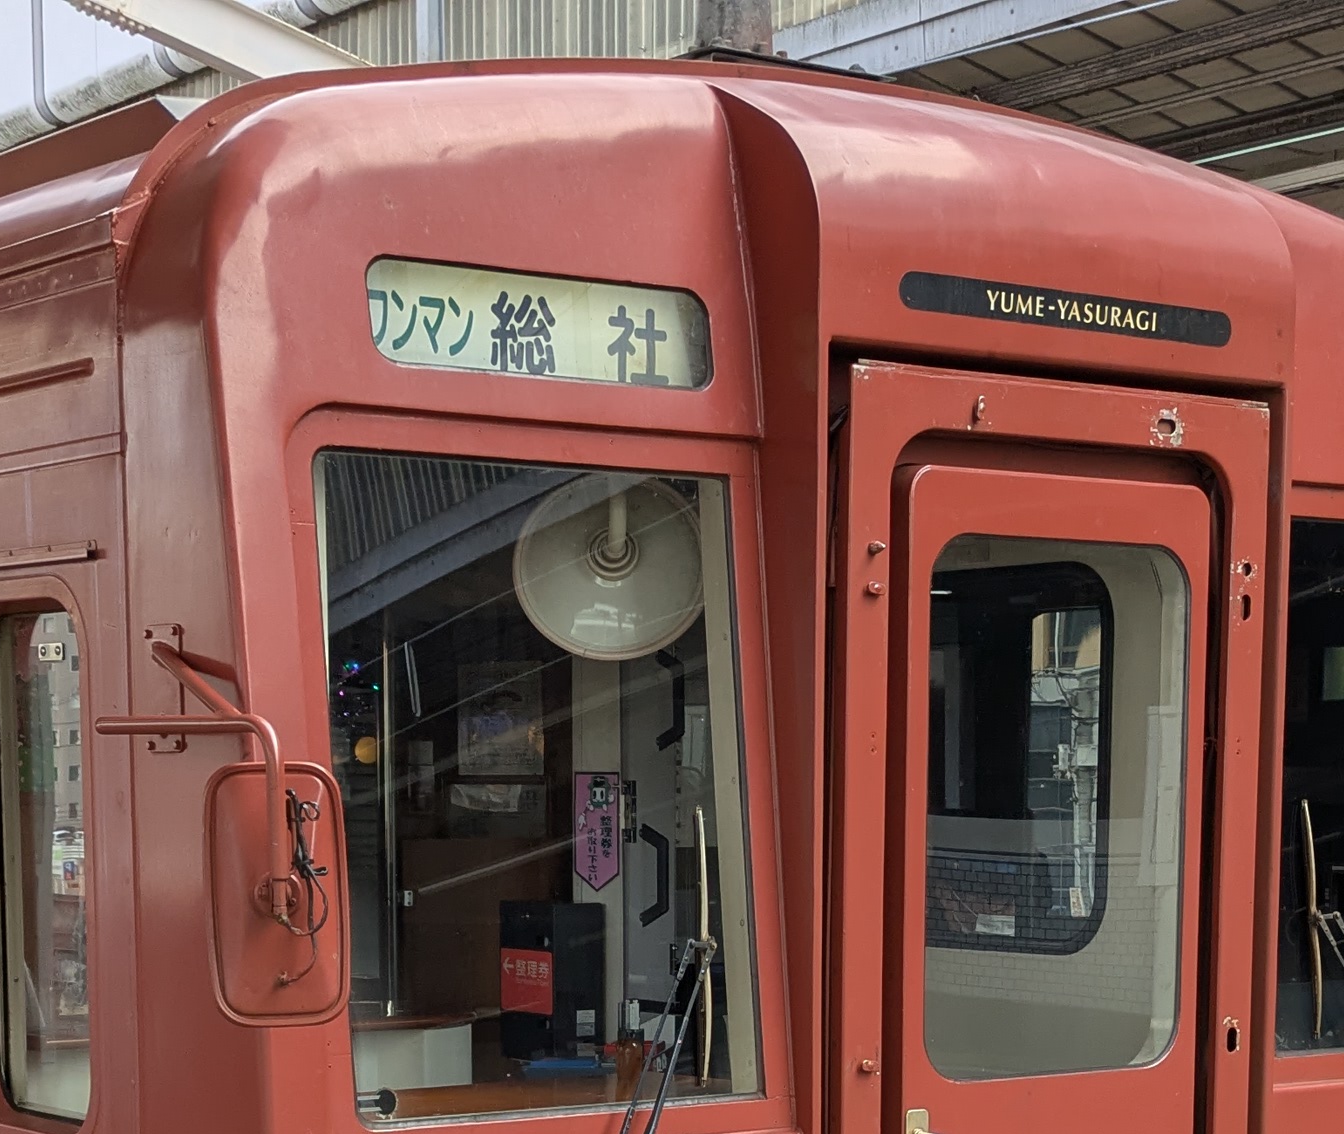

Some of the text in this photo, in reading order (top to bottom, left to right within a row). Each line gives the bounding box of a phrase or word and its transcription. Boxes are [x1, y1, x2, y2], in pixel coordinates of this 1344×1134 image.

[986, 289, 1158, 332] YUME-YASURAGI
[600, 815, 613, 858] 整理券を
[515, 959, 550, 979] 整理券
